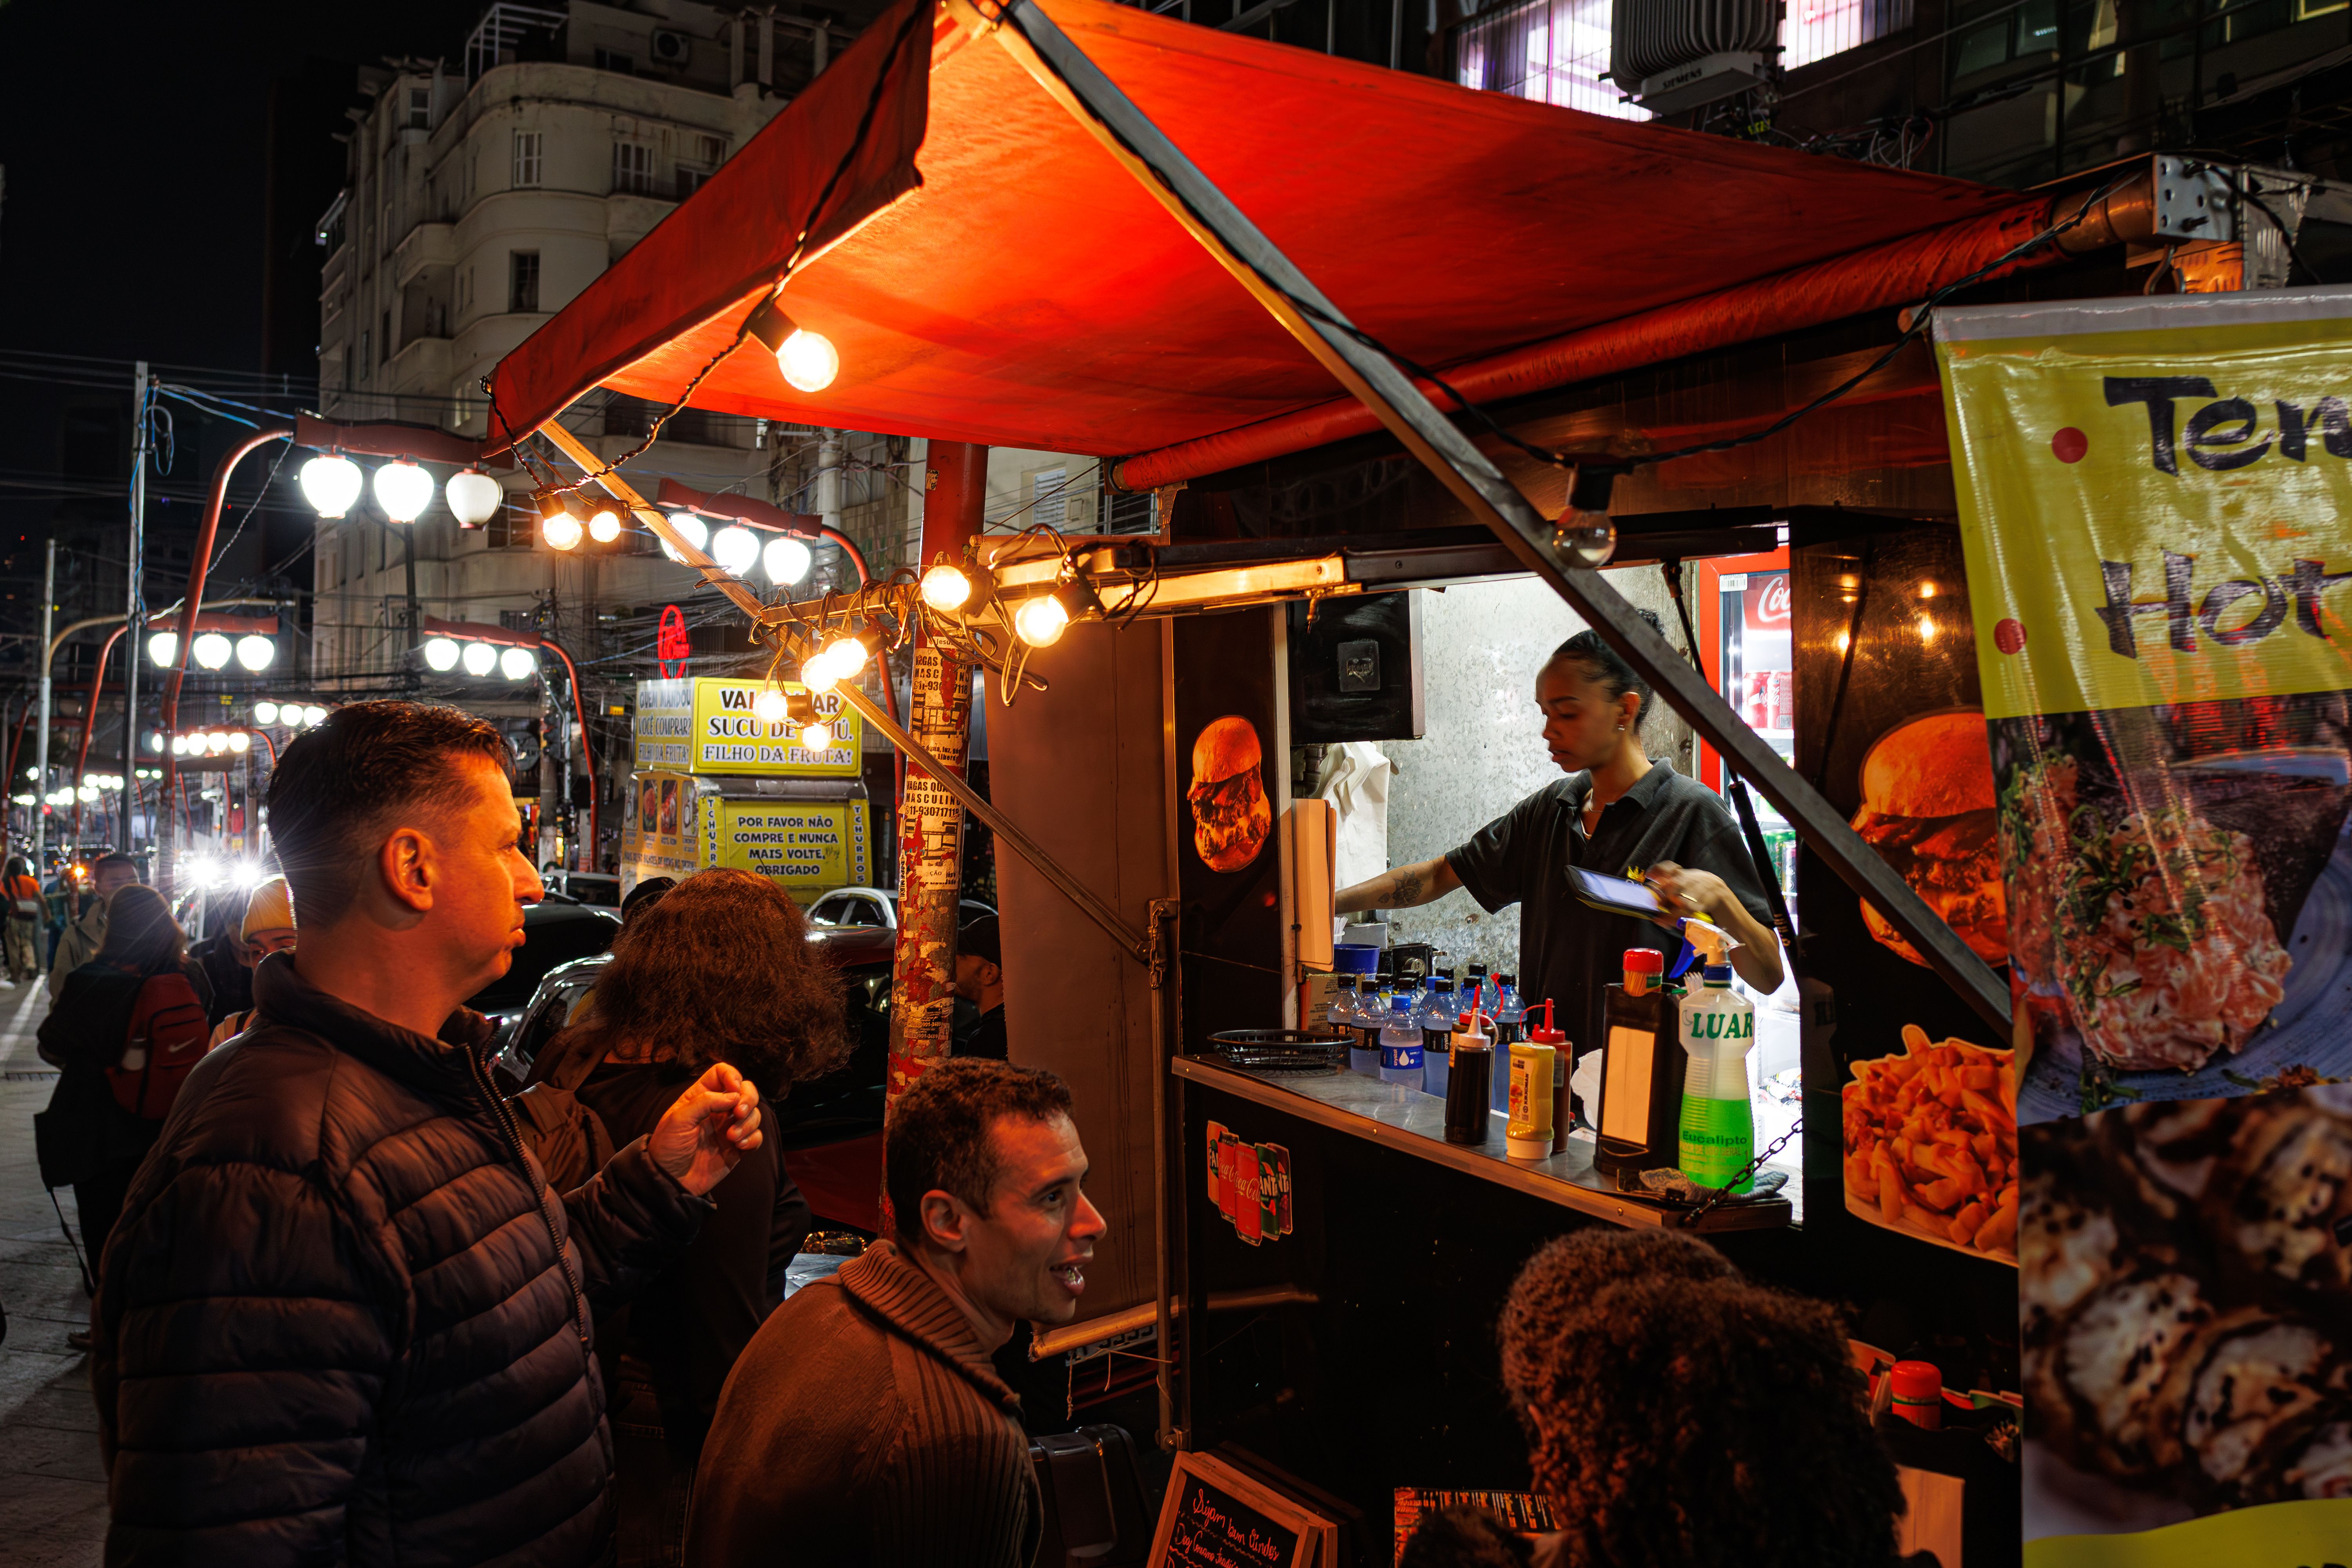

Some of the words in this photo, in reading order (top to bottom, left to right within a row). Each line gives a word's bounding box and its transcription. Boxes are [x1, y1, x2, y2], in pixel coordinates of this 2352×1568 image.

[1662, 67, 1702, 89] SIEMENS
[2095, 546, 2352, 659] Hot
[916, 655, 938, 666] VAGAS
[722, 690, 755, 710] VAI
[656, 717, 691, 736] COMPRAR?
[710, 718, 762, 737] SUCU
[771, 720, 795, 737] DE
[705, 746, 754, 761] FILHO
[760, 747, 783, 761] DA
[790, 748, 851, 763] FRUTA!
[907, 780, 928, 791] VAGAS
[906, 793, 960, 806] MASCULINO
[738, 817, 763, 827] POR
[768, 817, 804, 828] FAVOR
[808, 815, 833, 828] NÃO
[734, 833, 784, 843] COMPRE
[788, 833, 795, 843] E
[799, 833, 838, 843] NUNCA
[853, 806, 865, 884] TCHURROS
[749, 849, 783, 859] MAIS
[755, 865, 820, 875] OBRIGADO
[1691, 1012, 1753, 1039] LUAR
[1682, 1131, 1747, 1146] Eucalipto
[1720, 1147, 1741, 1156] GERAL
